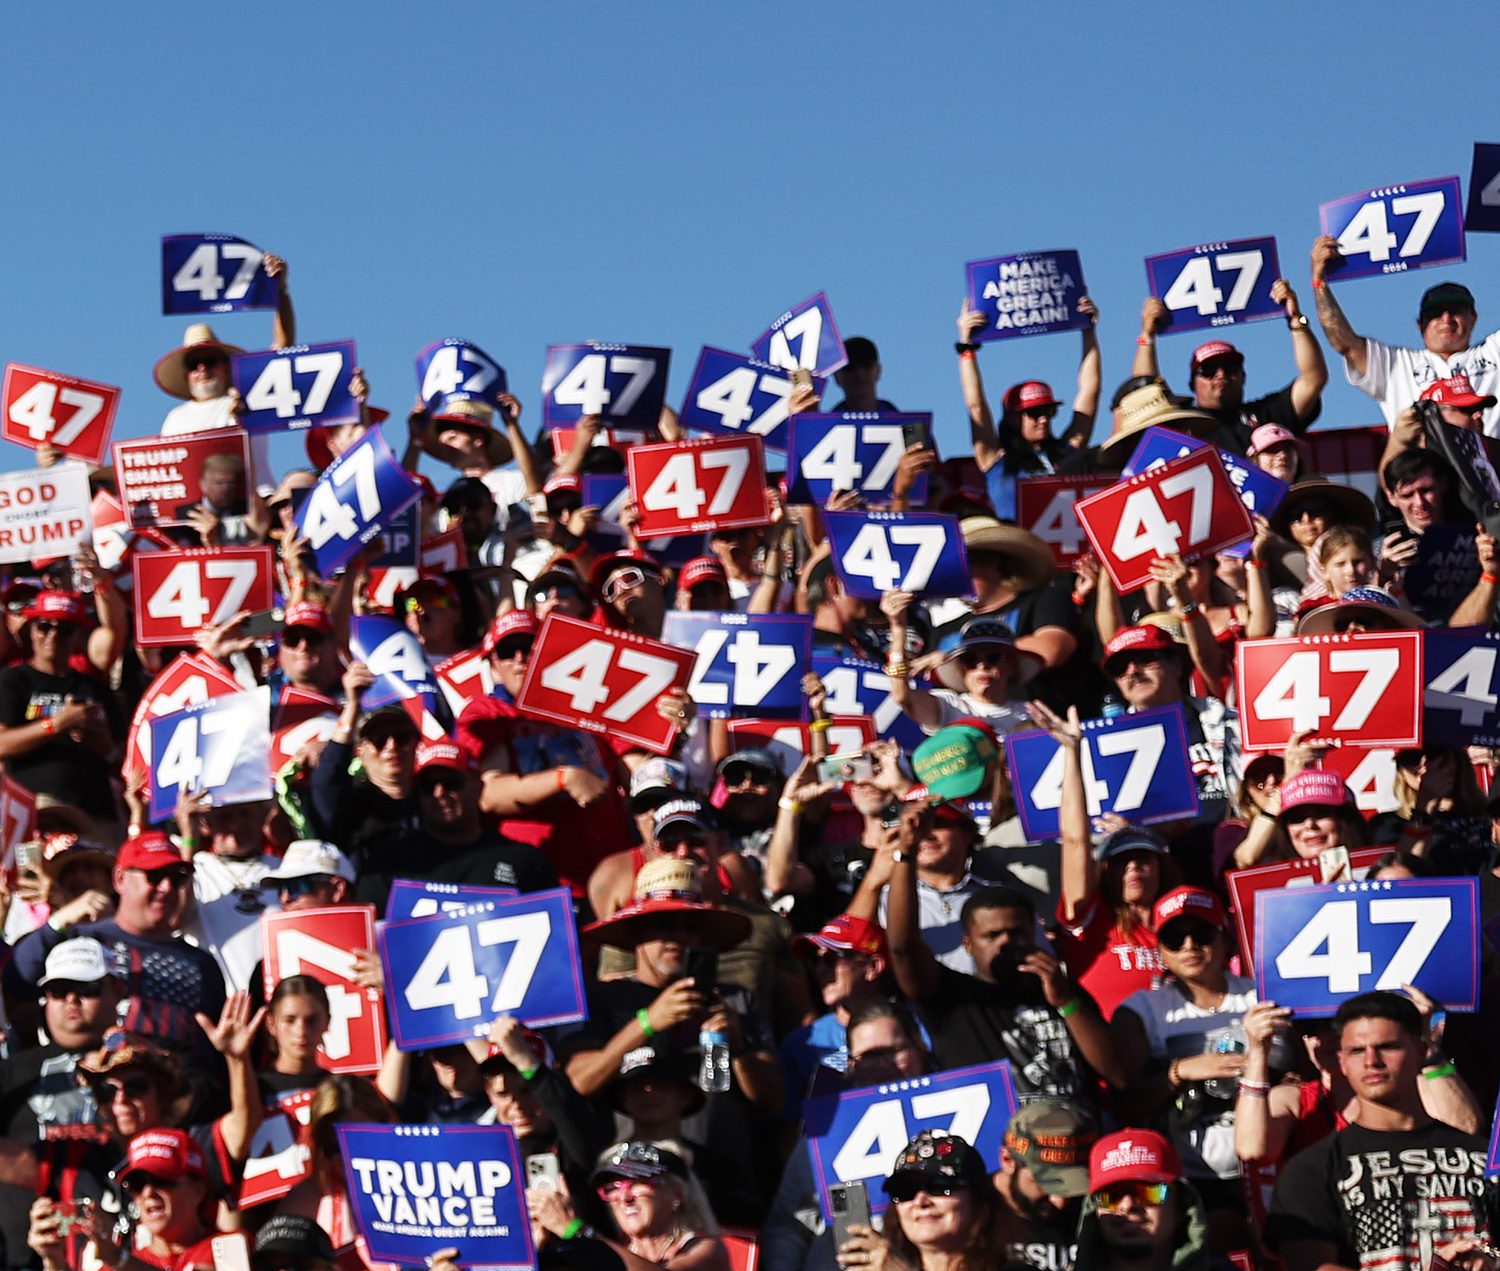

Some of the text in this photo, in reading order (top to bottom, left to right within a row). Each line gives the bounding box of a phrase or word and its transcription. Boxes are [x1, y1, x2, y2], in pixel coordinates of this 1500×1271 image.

[1338, 192, 1445, 261] 47
[174, 244, 264, 300] 47
[982, 272, 1075, 299] AMERICA
[996, 290, 1066, 313] GREAT
[999, 259, 1058, 281] MAKE
[1165, 249, 1264, 315] 47
[769, 305, 822, 369] 47
[996, 306, 1070, 330] AGAIN!
[246, 352, 344, 418] 47
[422, 347, 499, 399] 47
[555, 355, 656, 415] 47
[698, 366, 789, 434] 47
[9, 382, 104, 445] 47
[123, 448, 189, 468] TRUMP
[124, 466, 183, 486] SHALL
[642, 448, 750, 518] 47
[802, 425, 903, 493] 47
[126, 484, 188, 502] NEVER
[303, 443, 382, 550] 47
[1112, 463, 1213, 561] 47
[842, 524, 946, 591] 47
[148, 561, 257, 628] 47
[541, 639, 678, 723] 47
[691, 630, 796, 703] 47
[1254, 649, 1399, 731] 47
[1427, 646, 1500, 727] 4
[157, 709, 253, 788] 47
[1030, 724, 1165, 813] 47
[405, 912, 551, 1020] 47
[1275, 898, 1451, 993] 47
[243, 1108, 312, 1180] 4
[831, 1083, 990, 1183] 47
[351, 1157, 512, 1198] TRUMP
[1337, 1147, 1488, 1192] JESUS
[1342, 1175, 1486, 1211] IS MY SAVIO
[371, 1193, 497, 1227] VANCE
